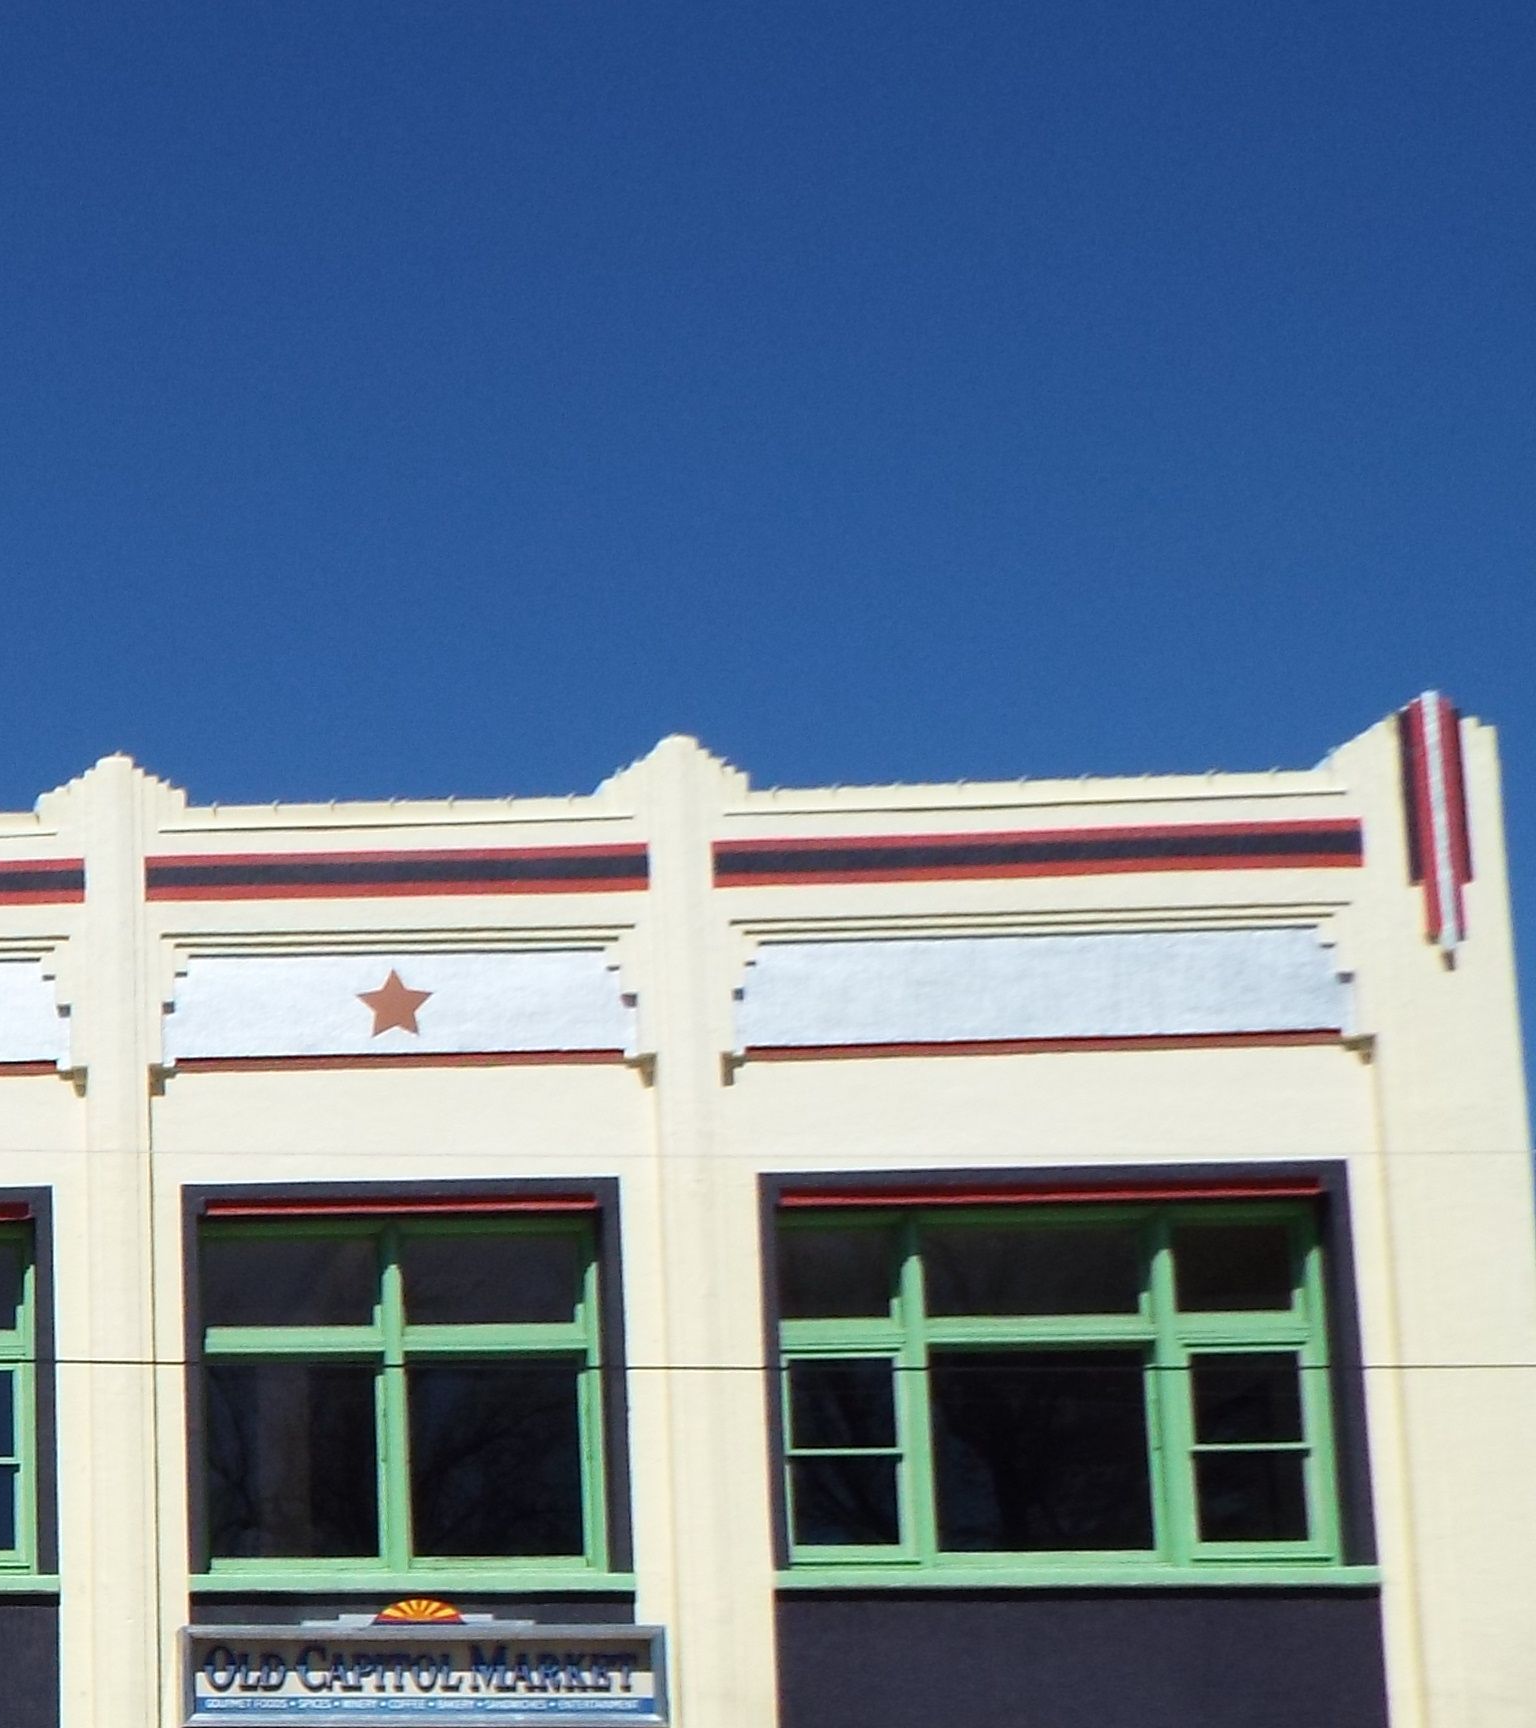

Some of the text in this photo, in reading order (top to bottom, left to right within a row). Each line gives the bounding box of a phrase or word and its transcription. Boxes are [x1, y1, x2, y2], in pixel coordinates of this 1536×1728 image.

[203, 1645, 637, 1693] OLD CAPITOL MARKET
